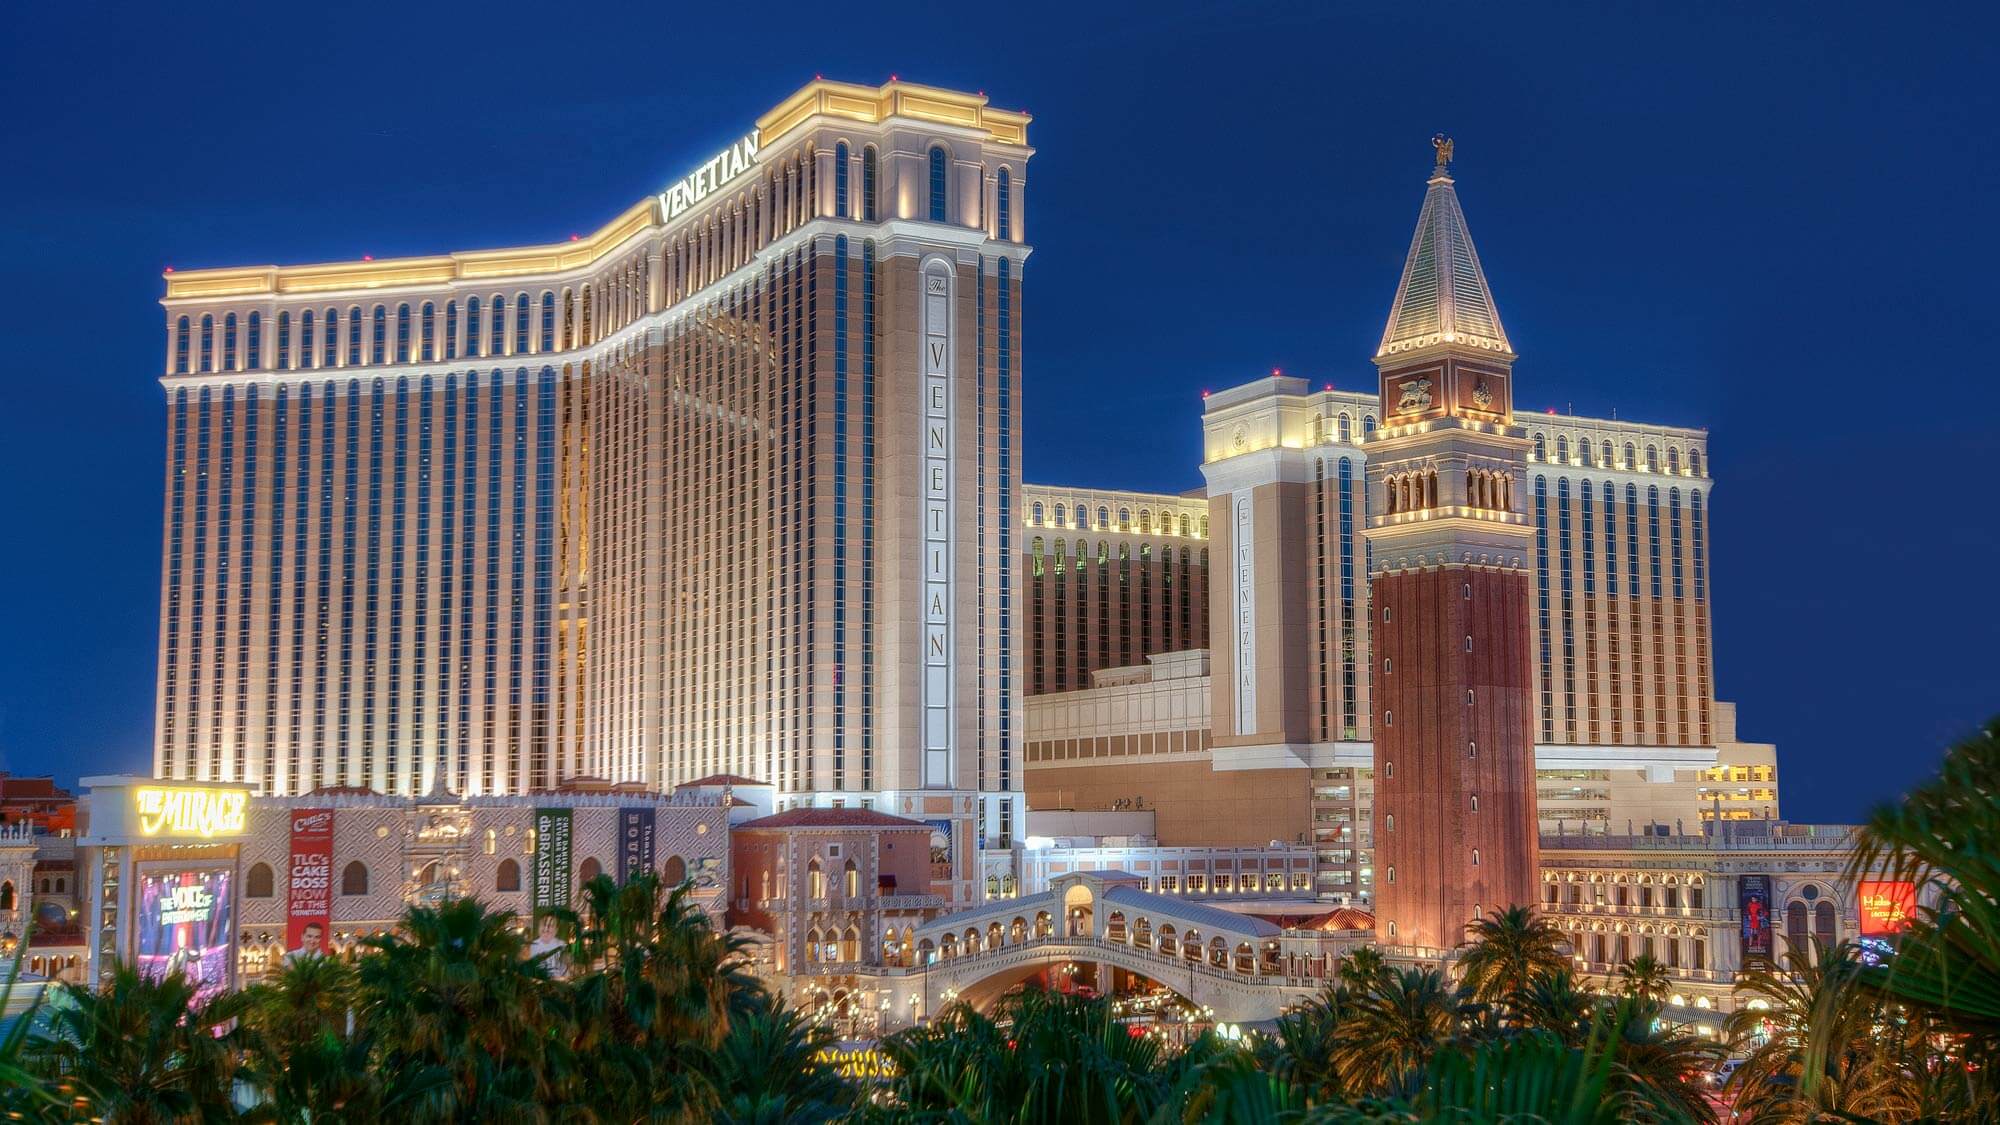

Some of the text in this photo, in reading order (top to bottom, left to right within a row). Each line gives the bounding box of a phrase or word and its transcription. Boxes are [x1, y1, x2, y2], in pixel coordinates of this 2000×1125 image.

[658, 130, 760, 223] VENETIAN
[928, 279, 945, 291] The
[930, 342, 944, 657] VENETIAN
[1241, 549, 1250, 687] VENEZIA
[136, 790, 247, 837] THE MIRAGE
[628, 814, 640, 872] BOUC
[644, 824, 652, 859] Thomas
[555, 854, 562, 864] TO
[292, 865, 329, 877] CAKE
[291, 877, 329, 889] BOSS
[291, 889, 328, 900] NOW
[172, 886, 205, 909] VOICE
[290, 900, 328, 909] AT THE
